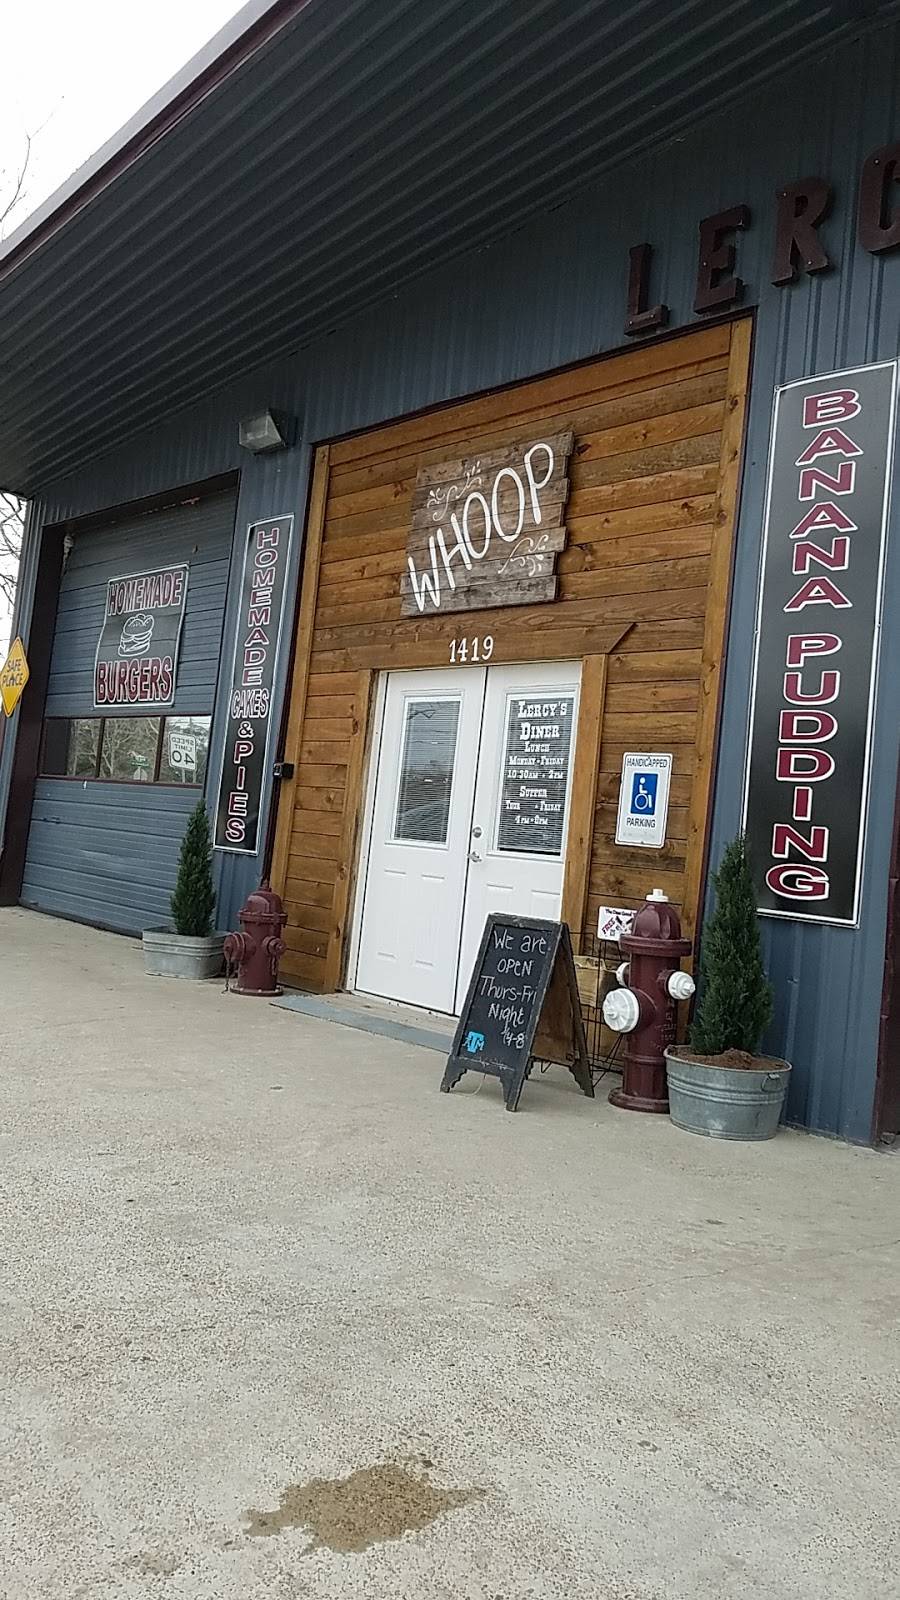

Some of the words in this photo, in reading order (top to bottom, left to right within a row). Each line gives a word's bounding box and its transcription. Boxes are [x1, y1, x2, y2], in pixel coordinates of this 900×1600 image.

[783, 388, 863, 612] BANANA
[408, 442, 554, 612] WHOOP
[106, 570, 184, 616] HOMEMADE
[242, 526, 280, 687] HOMEMADE
[449, 635, 494, 663] 1419
[96, 655, 173, 704] BURGERS
[230, 687, 270, 719] CAKES
[237, 721, 254, 739] &
[519, 722, 560, 740] DINER
[524, 740, 550, 753] LUNCH
[626, 757, 668, 768] HANDICAPPED
[765, 632, 843, 902] PUDDING
[225, 740, 254, 844] PIES
[519, 785, 547, 798] SUPPER
[626, 817, 656, 828] PARKING
[494, 928, 513, 949] We
[520, 935, 547, 954] are
[481, 975, 538, 1005] Thurs-Fri
[488, 1003, 525, 1027] Night
